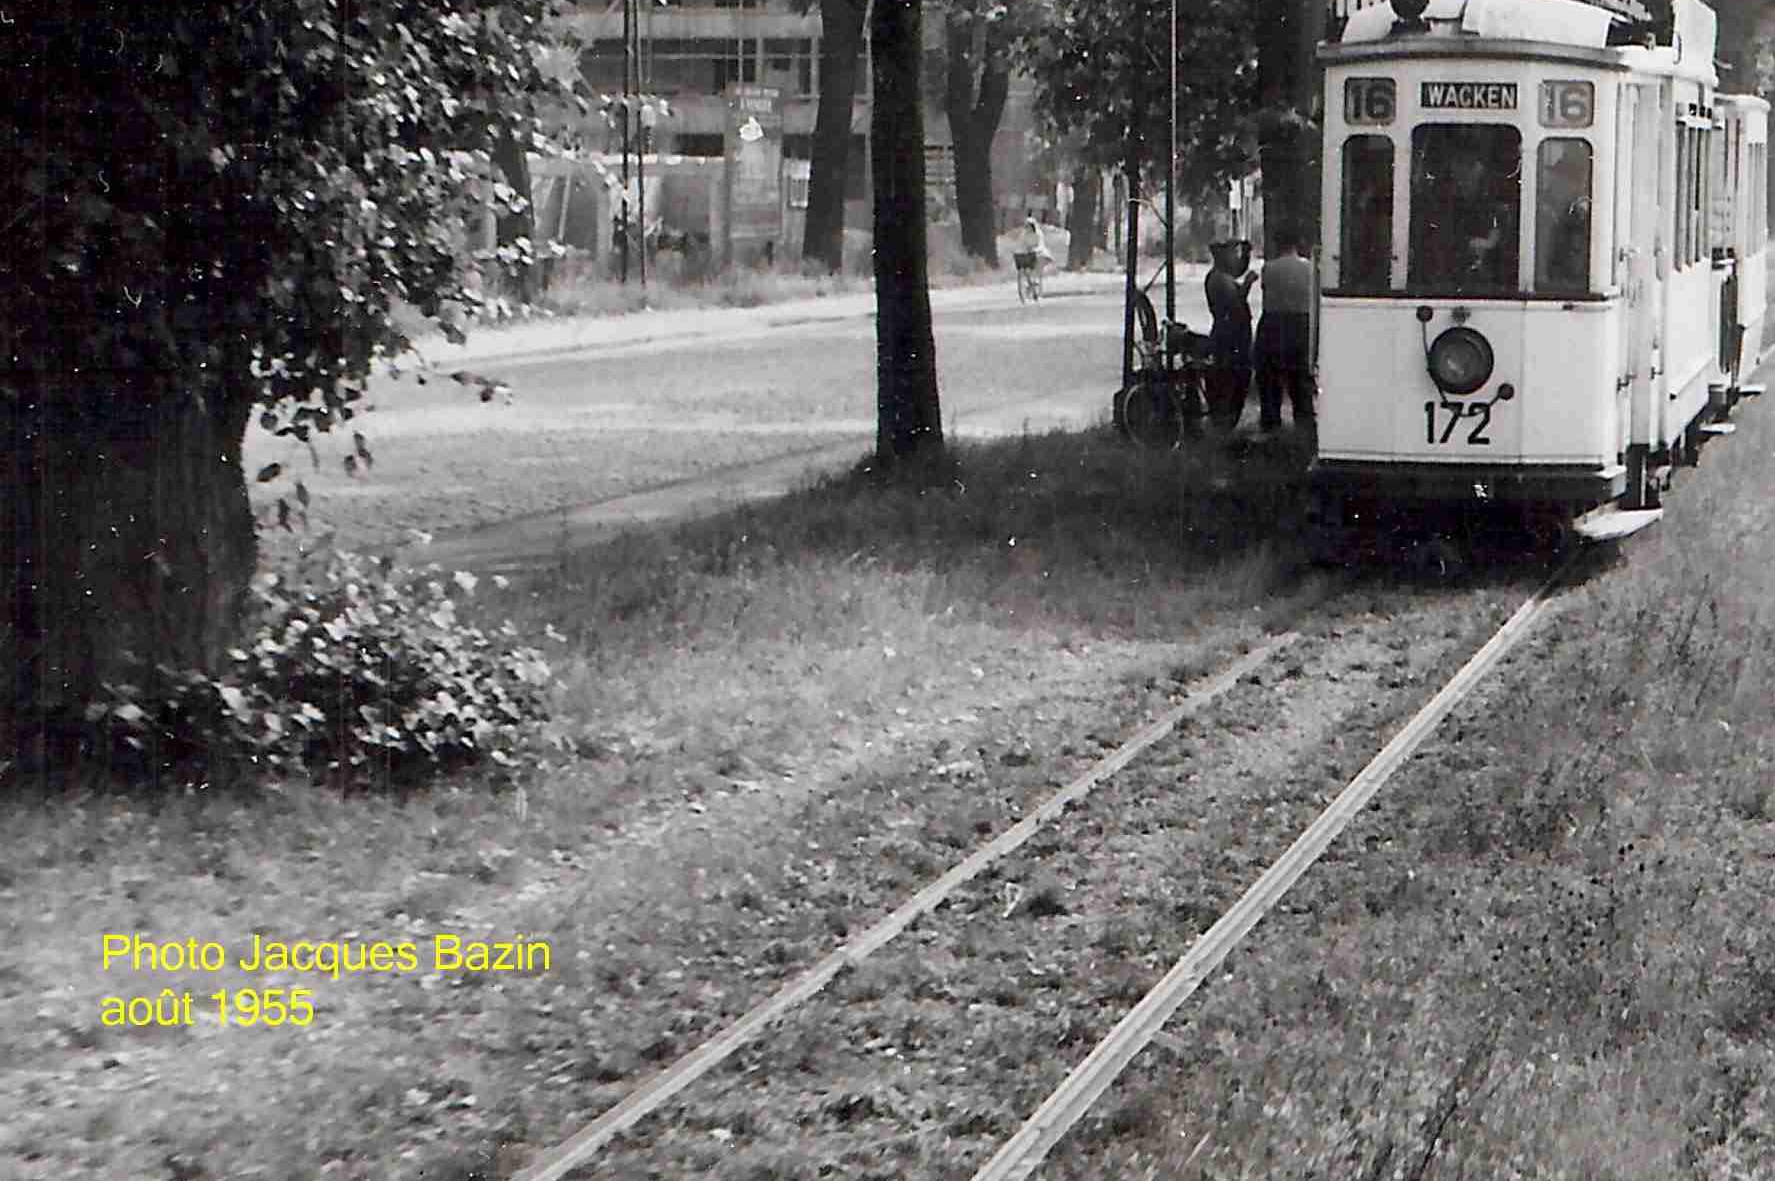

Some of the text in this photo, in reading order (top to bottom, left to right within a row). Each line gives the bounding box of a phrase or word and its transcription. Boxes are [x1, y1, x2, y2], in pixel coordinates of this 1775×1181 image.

[1349, 83, 1393, 119] 16
[1427, 83, 1516, 108] WACKEN
[1546, 84, 1588, 120] 16
[1424, 401, 1491, 445] 172
